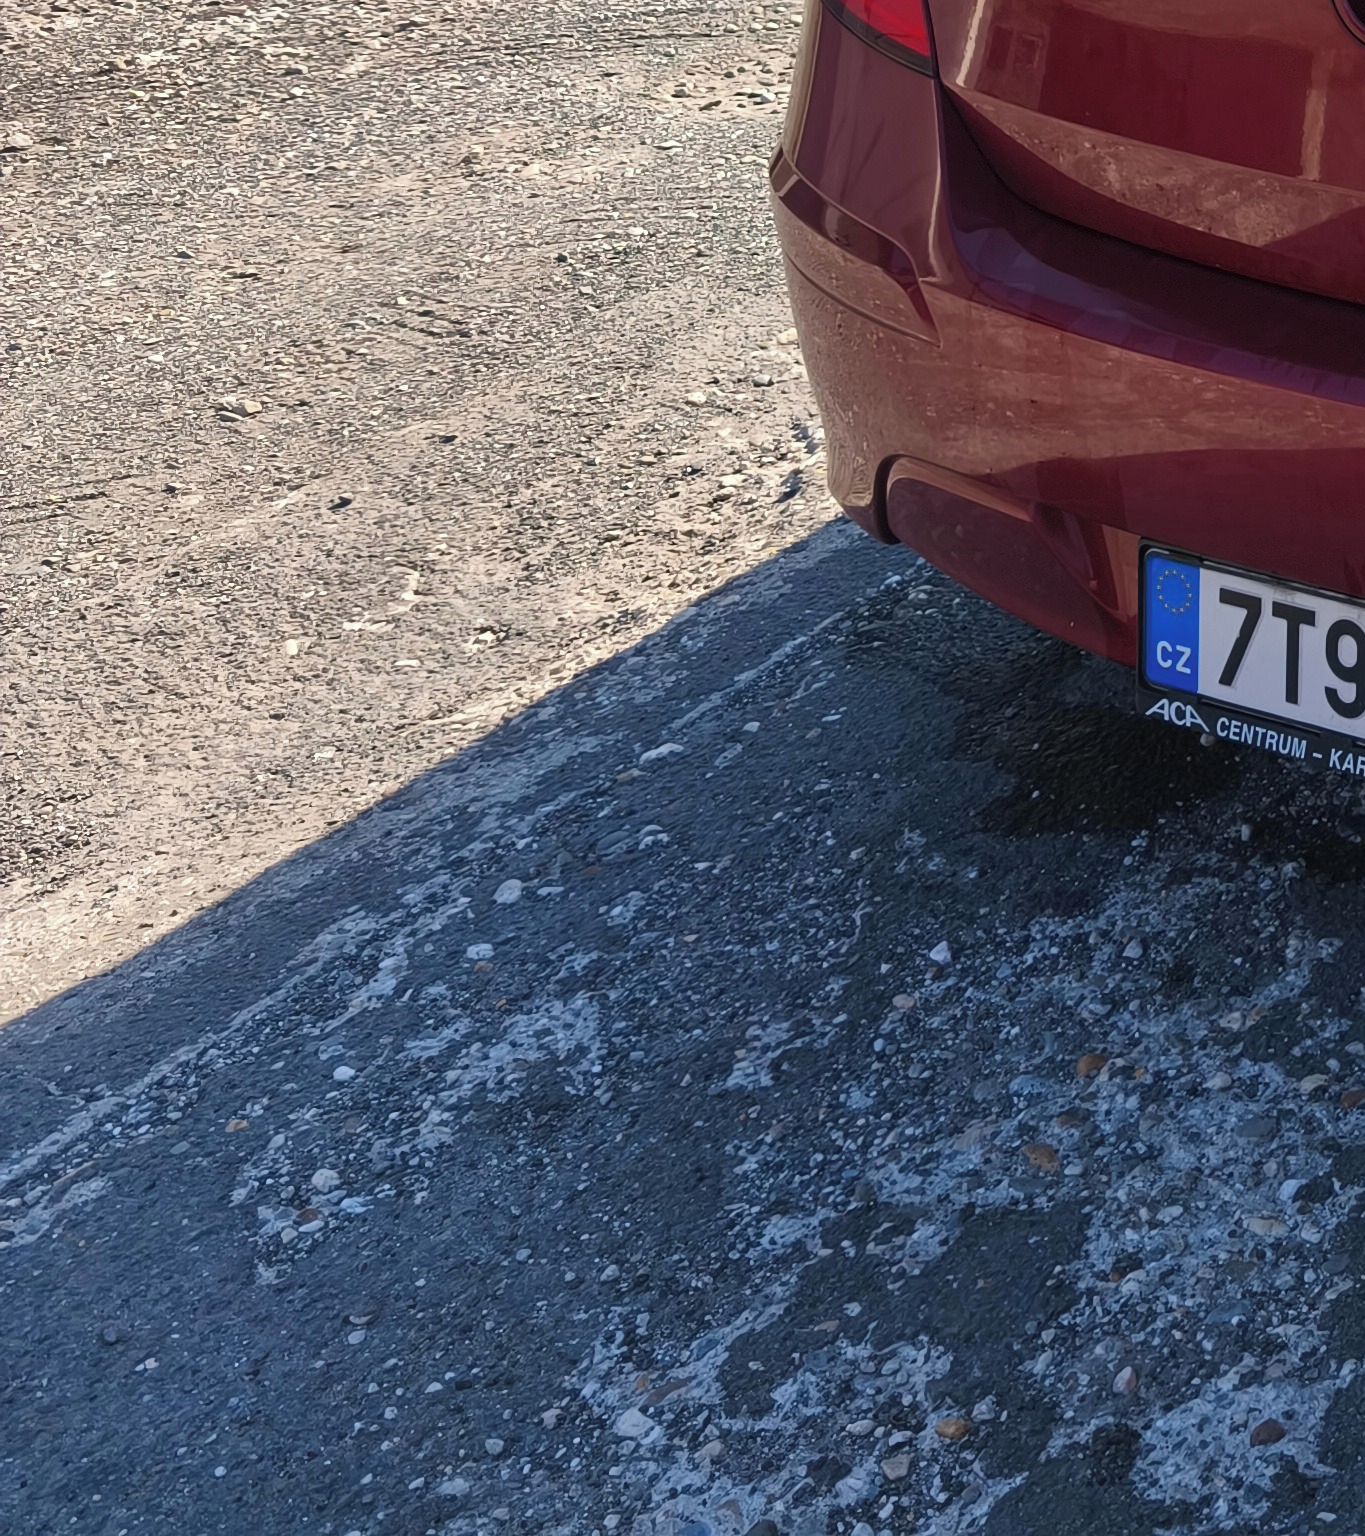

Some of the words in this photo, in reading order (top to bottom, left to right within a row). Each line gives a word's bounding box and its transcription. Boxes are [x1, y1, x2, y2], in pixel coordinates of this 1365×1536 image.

[1156, 640, 1192, 675] CZ
[1145, 698, 1210, 733] ACA
[1216, 716, 1307, 759] CENTRUM
